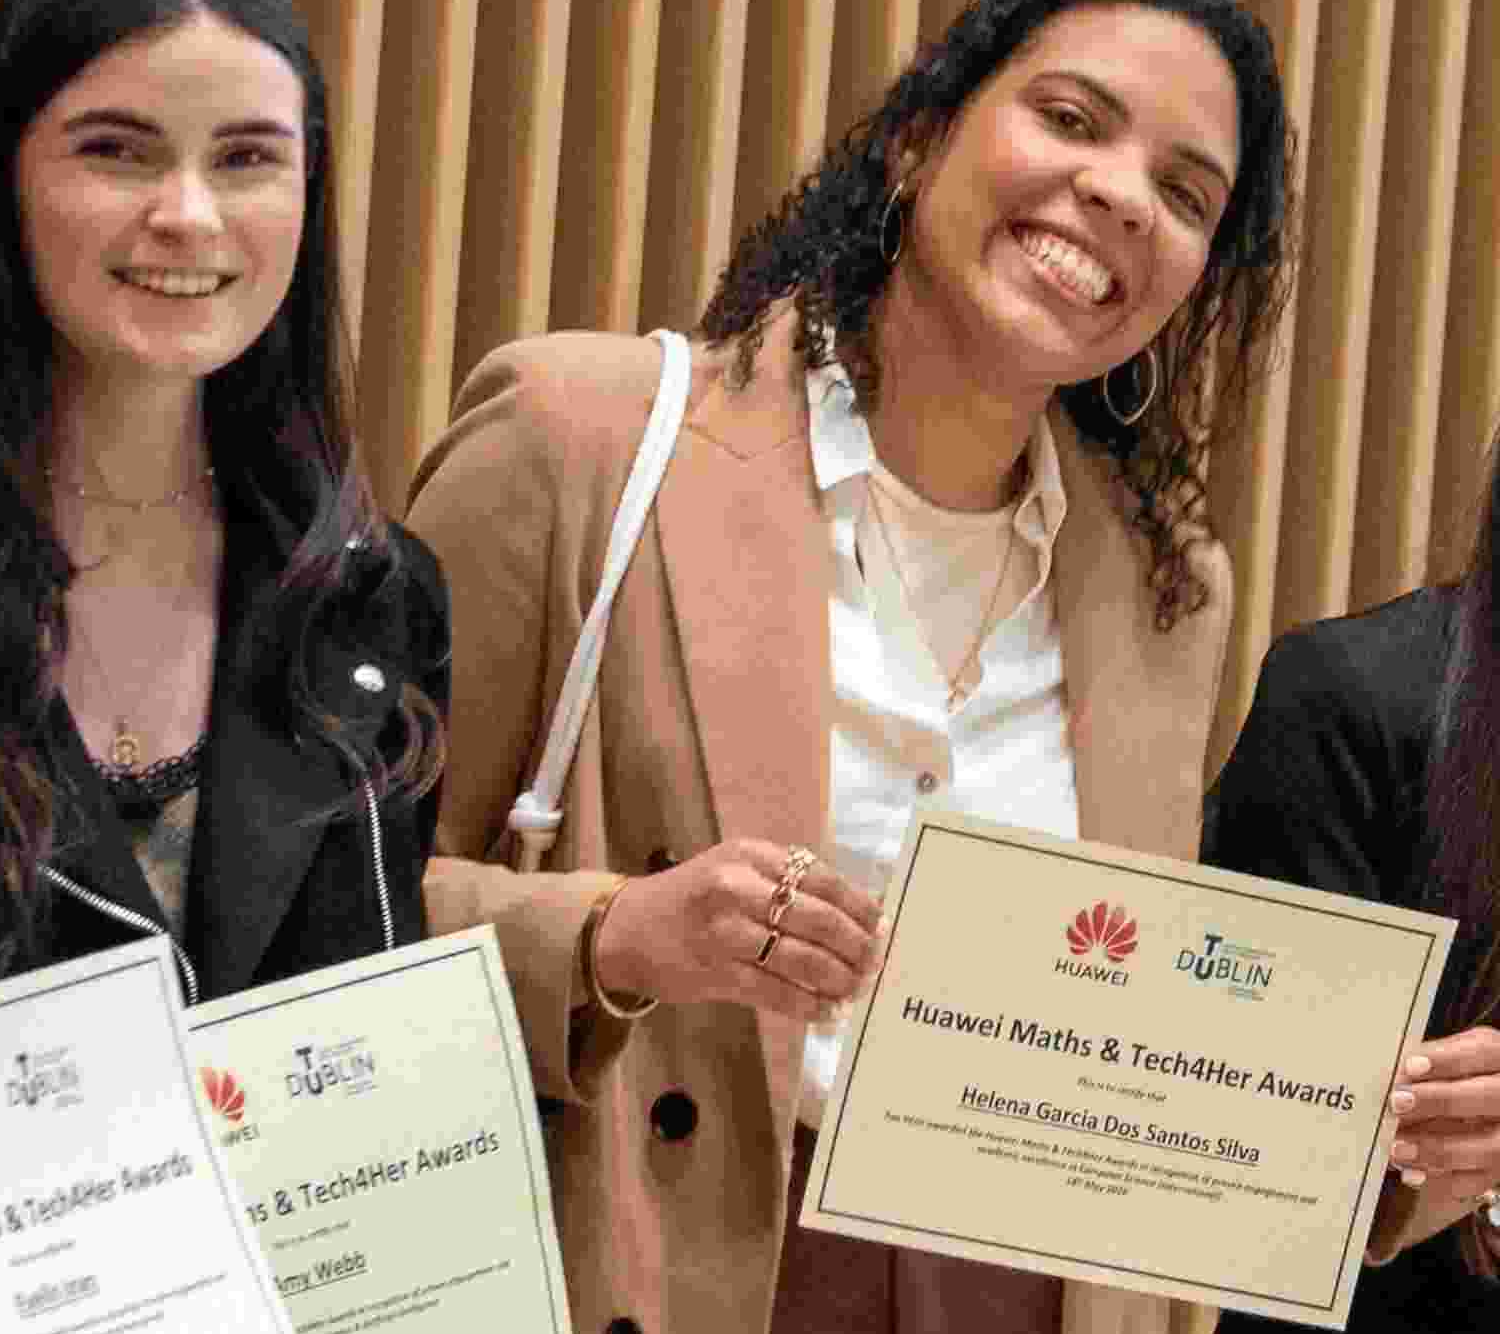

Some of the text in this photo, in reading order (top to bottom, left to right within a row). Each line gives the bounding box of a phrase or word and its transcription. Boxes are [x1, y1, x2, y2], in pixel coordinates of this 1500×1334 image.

[1054, 956, 1131, 988] HUAWEI
[1174, 947, 1274, 989] DUBLIN
[284, 1053, 375, 1099] DUBLIN
[901, 995, 1356, 1113] Huawei Maths & Tech4Her Awards
[960, 1084, 1262, 1164] Helena Garcia Dos Santos Silva
[4, 1203, 25, 1234] &
[24, 1178, 117, 1224] Tech4Her
[119, 1149, 194, 1194] Awards
[274, 1188, 297, 1218] &
[297, 1156, 409, 1210] Tech4Her
[414, 1126, 501, 1176] Awards
[312, 1249, 368, 1283] Webb
